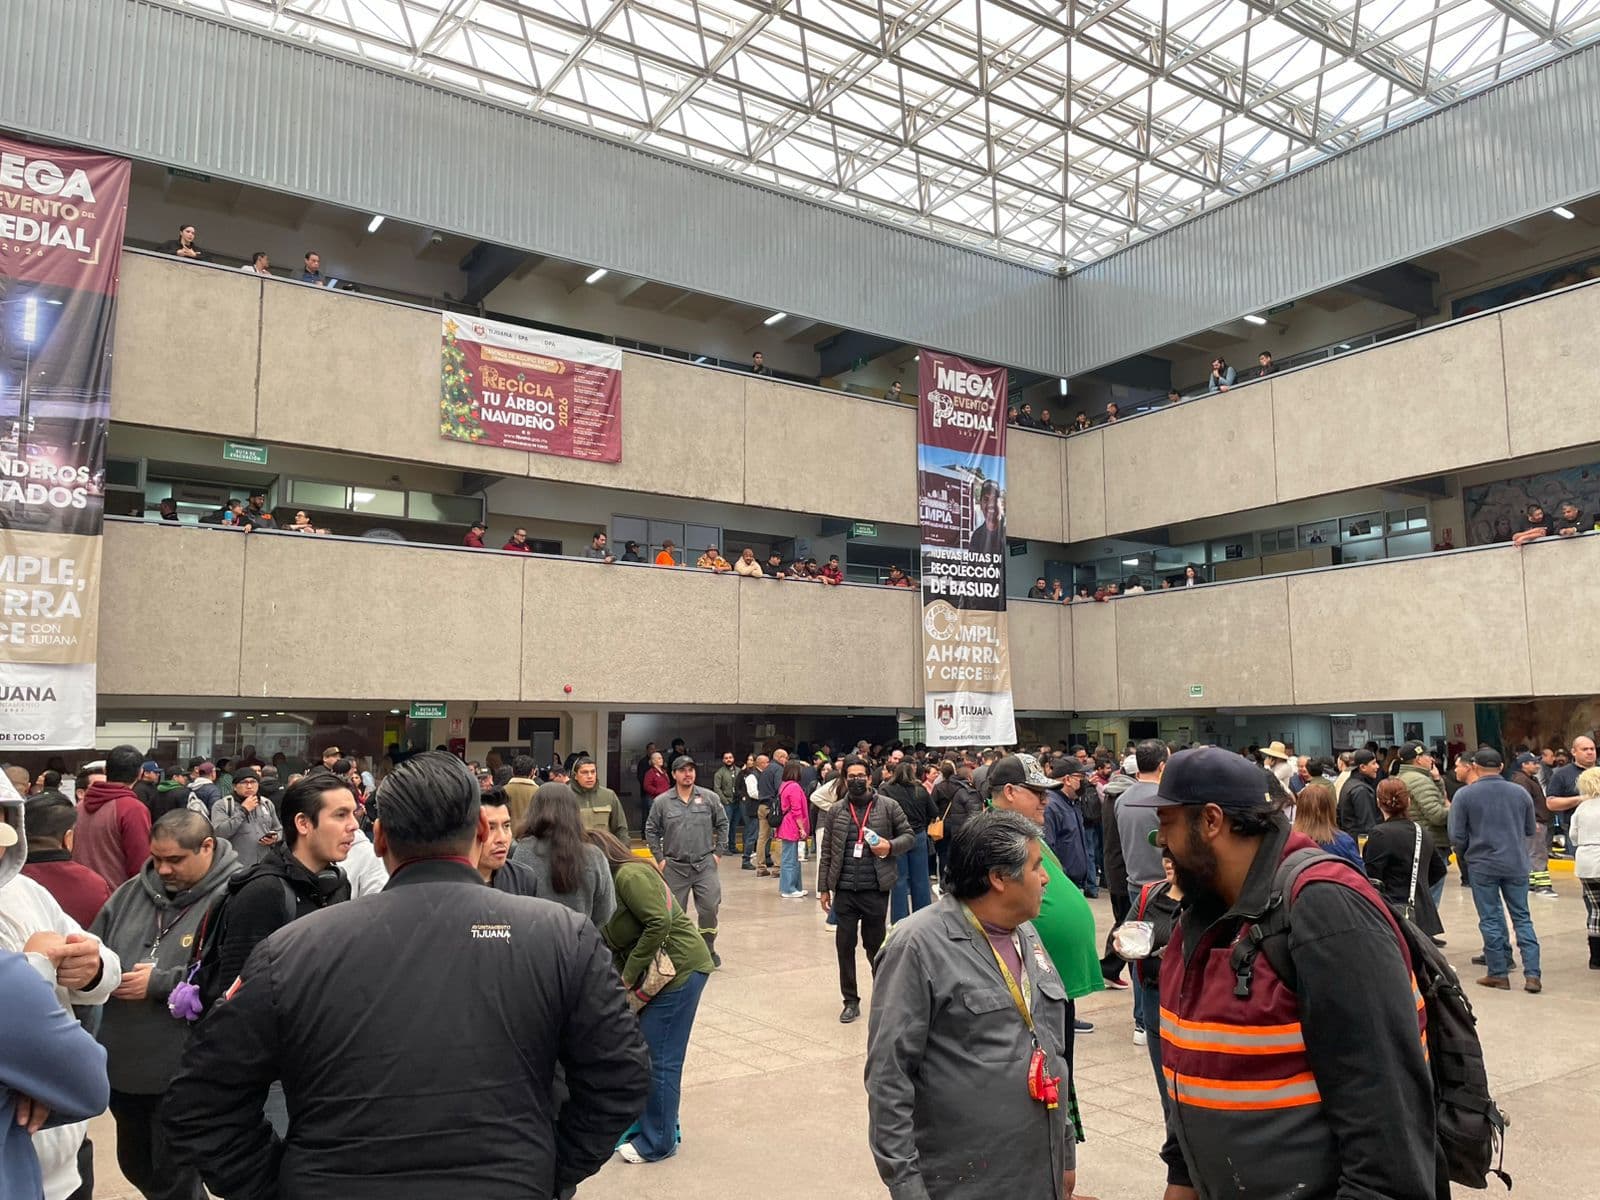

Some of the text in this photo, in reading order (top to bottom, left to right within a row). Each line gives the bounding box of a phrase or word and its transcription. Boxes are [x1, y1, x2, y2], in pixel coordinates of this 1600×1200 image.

[479, 365, 555, 399] RECICLA
[937, 367, 995, 400] MEGA
[482, 391, 555, 415] TU ÁRBOL
[559, 397, 568, 426] 2026
[928, 390, 994, 432] PREDIAL
[953, 396, 989, 412] EVENTO
[481, 407, 555, 431] NAVIDEÑO
[963, 551, 991, 563] RUTAS
[993, 553, 1002, 564] D
[931, 578, 1000, 598] DE BASURA
[31, 624, 61, 633] CON
[31, 635, 78, 645] TIJUANA
[926, 665, 936, 679] Y
[940, 666, 983, 680] CRECE
[13, 733, 46, 741] TODOS
[470, 929, 511, 938] TIJUANA
